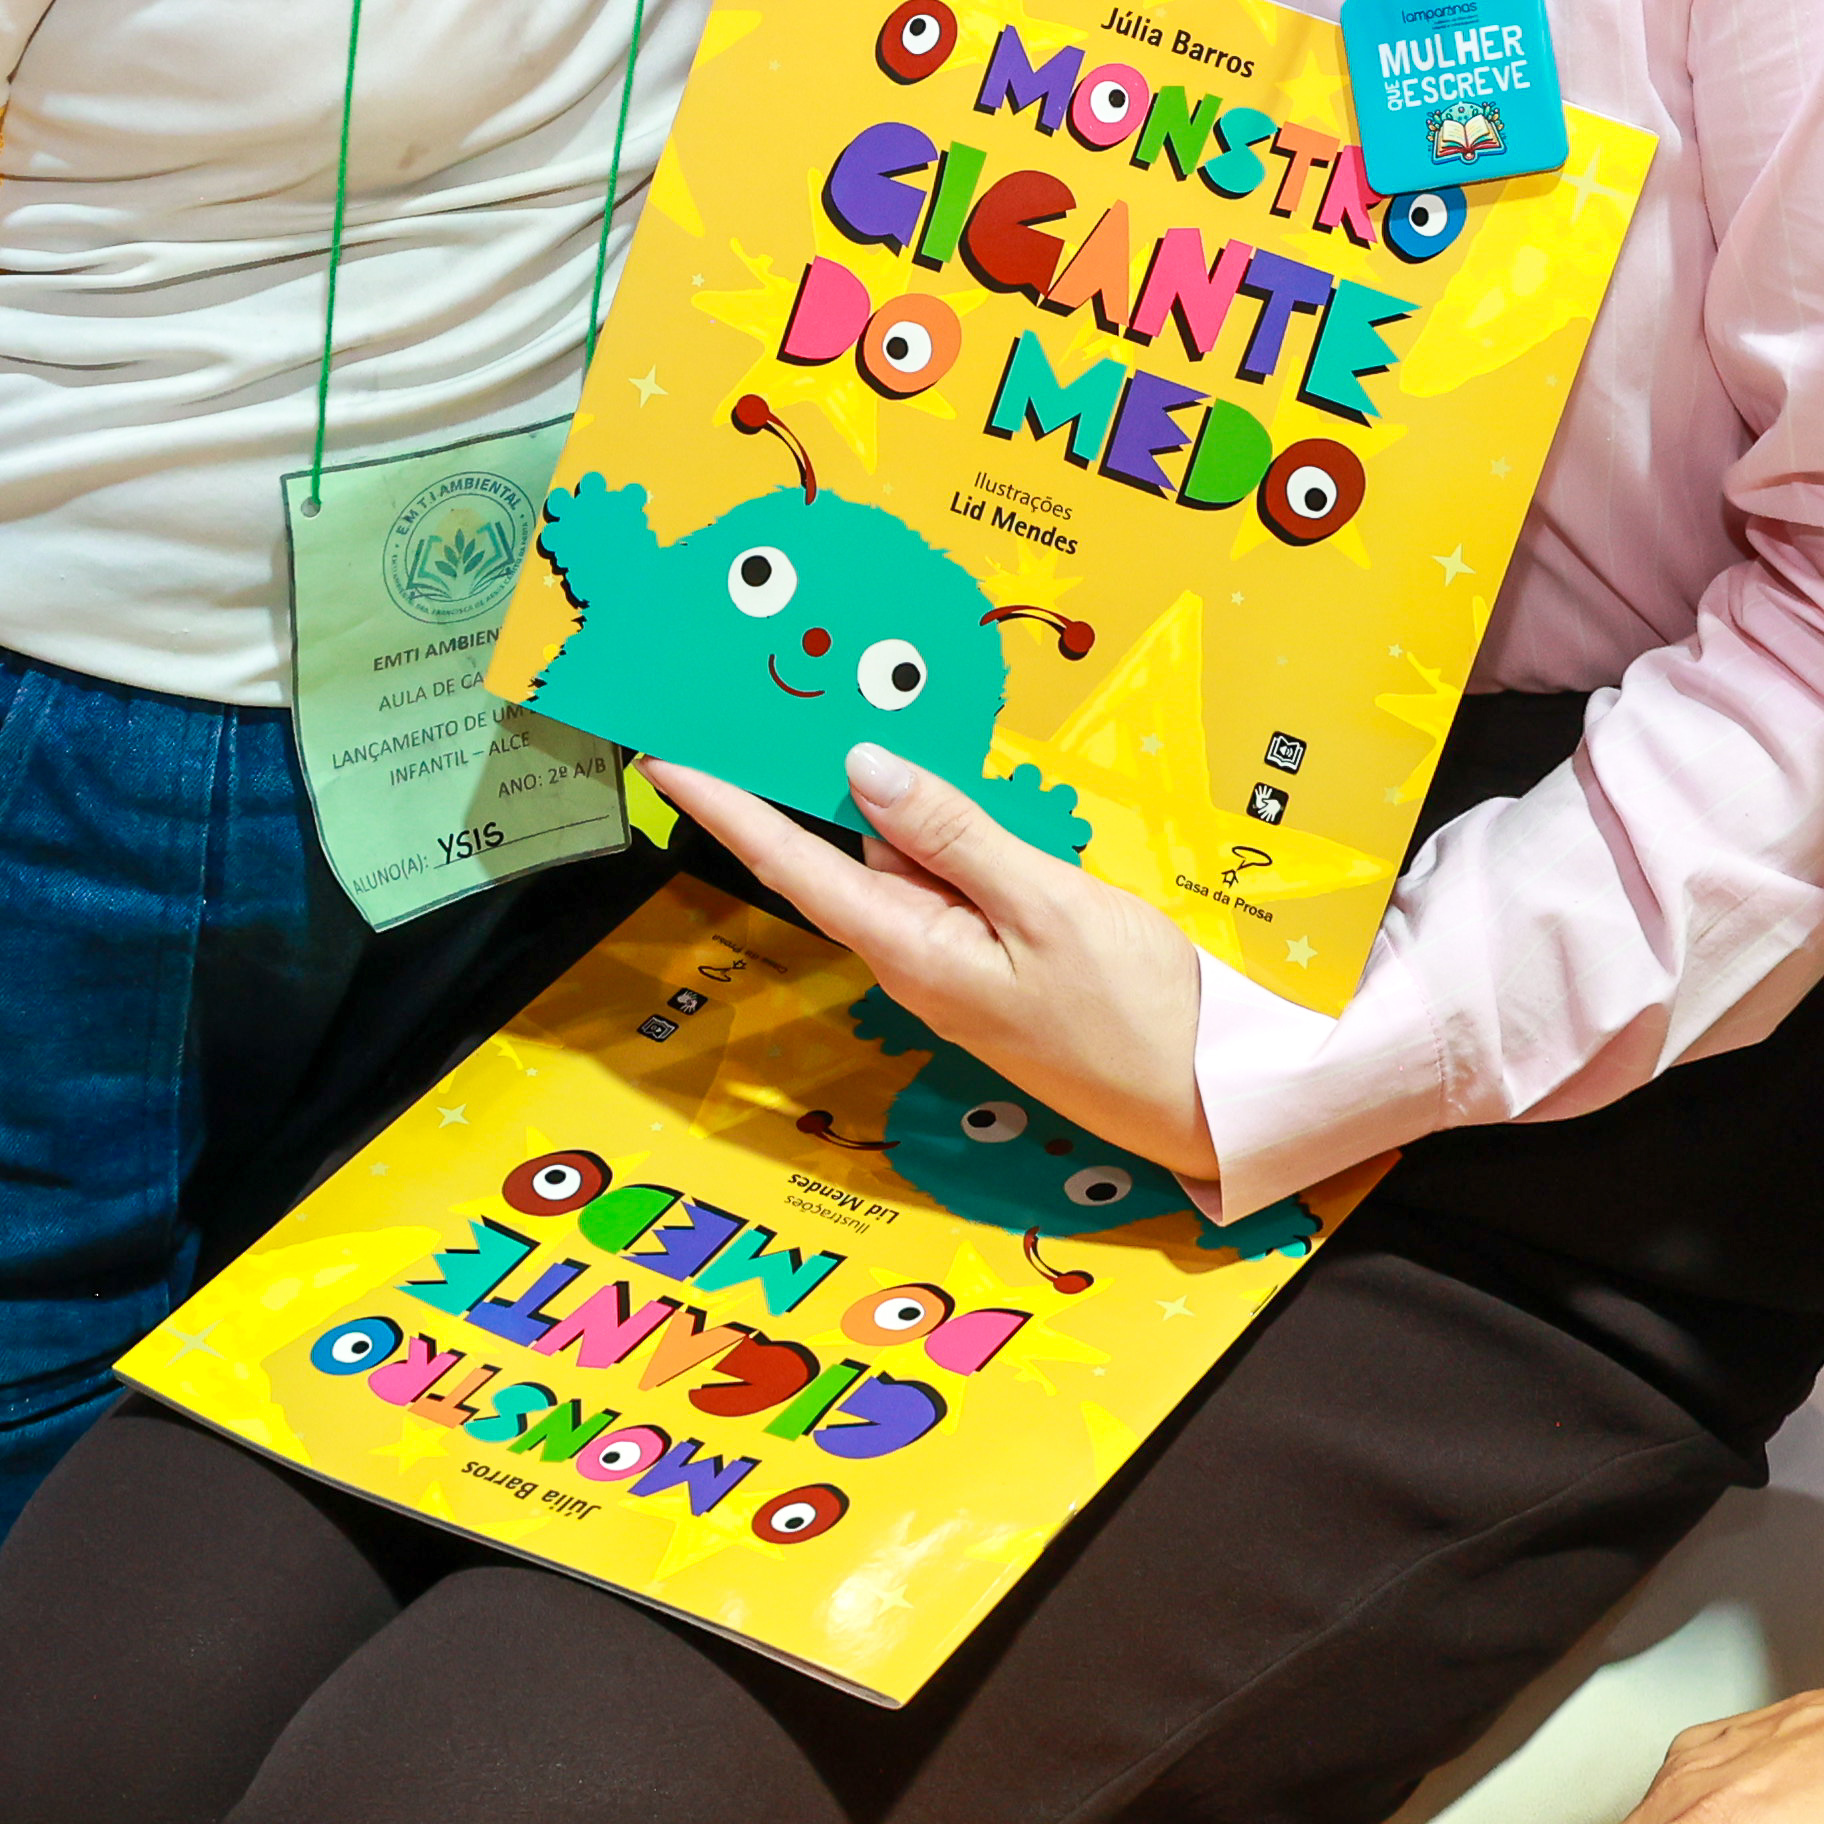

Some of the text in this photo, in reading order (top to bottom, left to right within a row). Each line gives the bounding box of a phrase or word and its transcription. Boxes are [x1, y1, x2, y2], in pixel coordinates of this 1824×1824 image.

[1101, 7, 1255, 78] Júlia Barros
[1378, 25, 1525, 78] MULHER
[1384, 60, 1531, 112] QUE ESCREVE
[976, 23, 1468, 265] MONSTRO
[822, 121, 1420, 428] GIGANTE
[777, 254, 1367, 548] DO MEDO
[439, 477, 522, 511] AMBIENTAL
[974, 471, 1073, 521] Ilustrações
[950, 491, 1079, 555] Lid Mendes
[373, 626, 503, 672] EMTI AMBIEN
[379, 688, 427, 712] AULA
[433, 678, 456, 697] DE
[332, 720, 460, 770] LANÇAMENTO
[464, 711, 487, 732] DE
[492, 706, 524, 724] UM
[390, 749, 470, 786] INFANTIL
[488, 731, 531, 757] ALCE
[498, 773, 544, 799] ANO:
[573, 756, 607, 780] A/B
[437, 821, 505, 865] YSIS
[353, 853, 429, 895] ALUNO(A):
[1175, 874, 1274, 923] Casa da Prosa
[784, 1195, 870, 1235] Ilustrações
[788, 1173, 900, 1225] Lid Mendes
[502, 1148, 1034, 1376] DO MEDO
[394, 1214, 949, 1460] GIGANTE
[310, 1315, 762, 1518] MONSTRO
[460, 1461, 602, 1521] Júlia Barros
